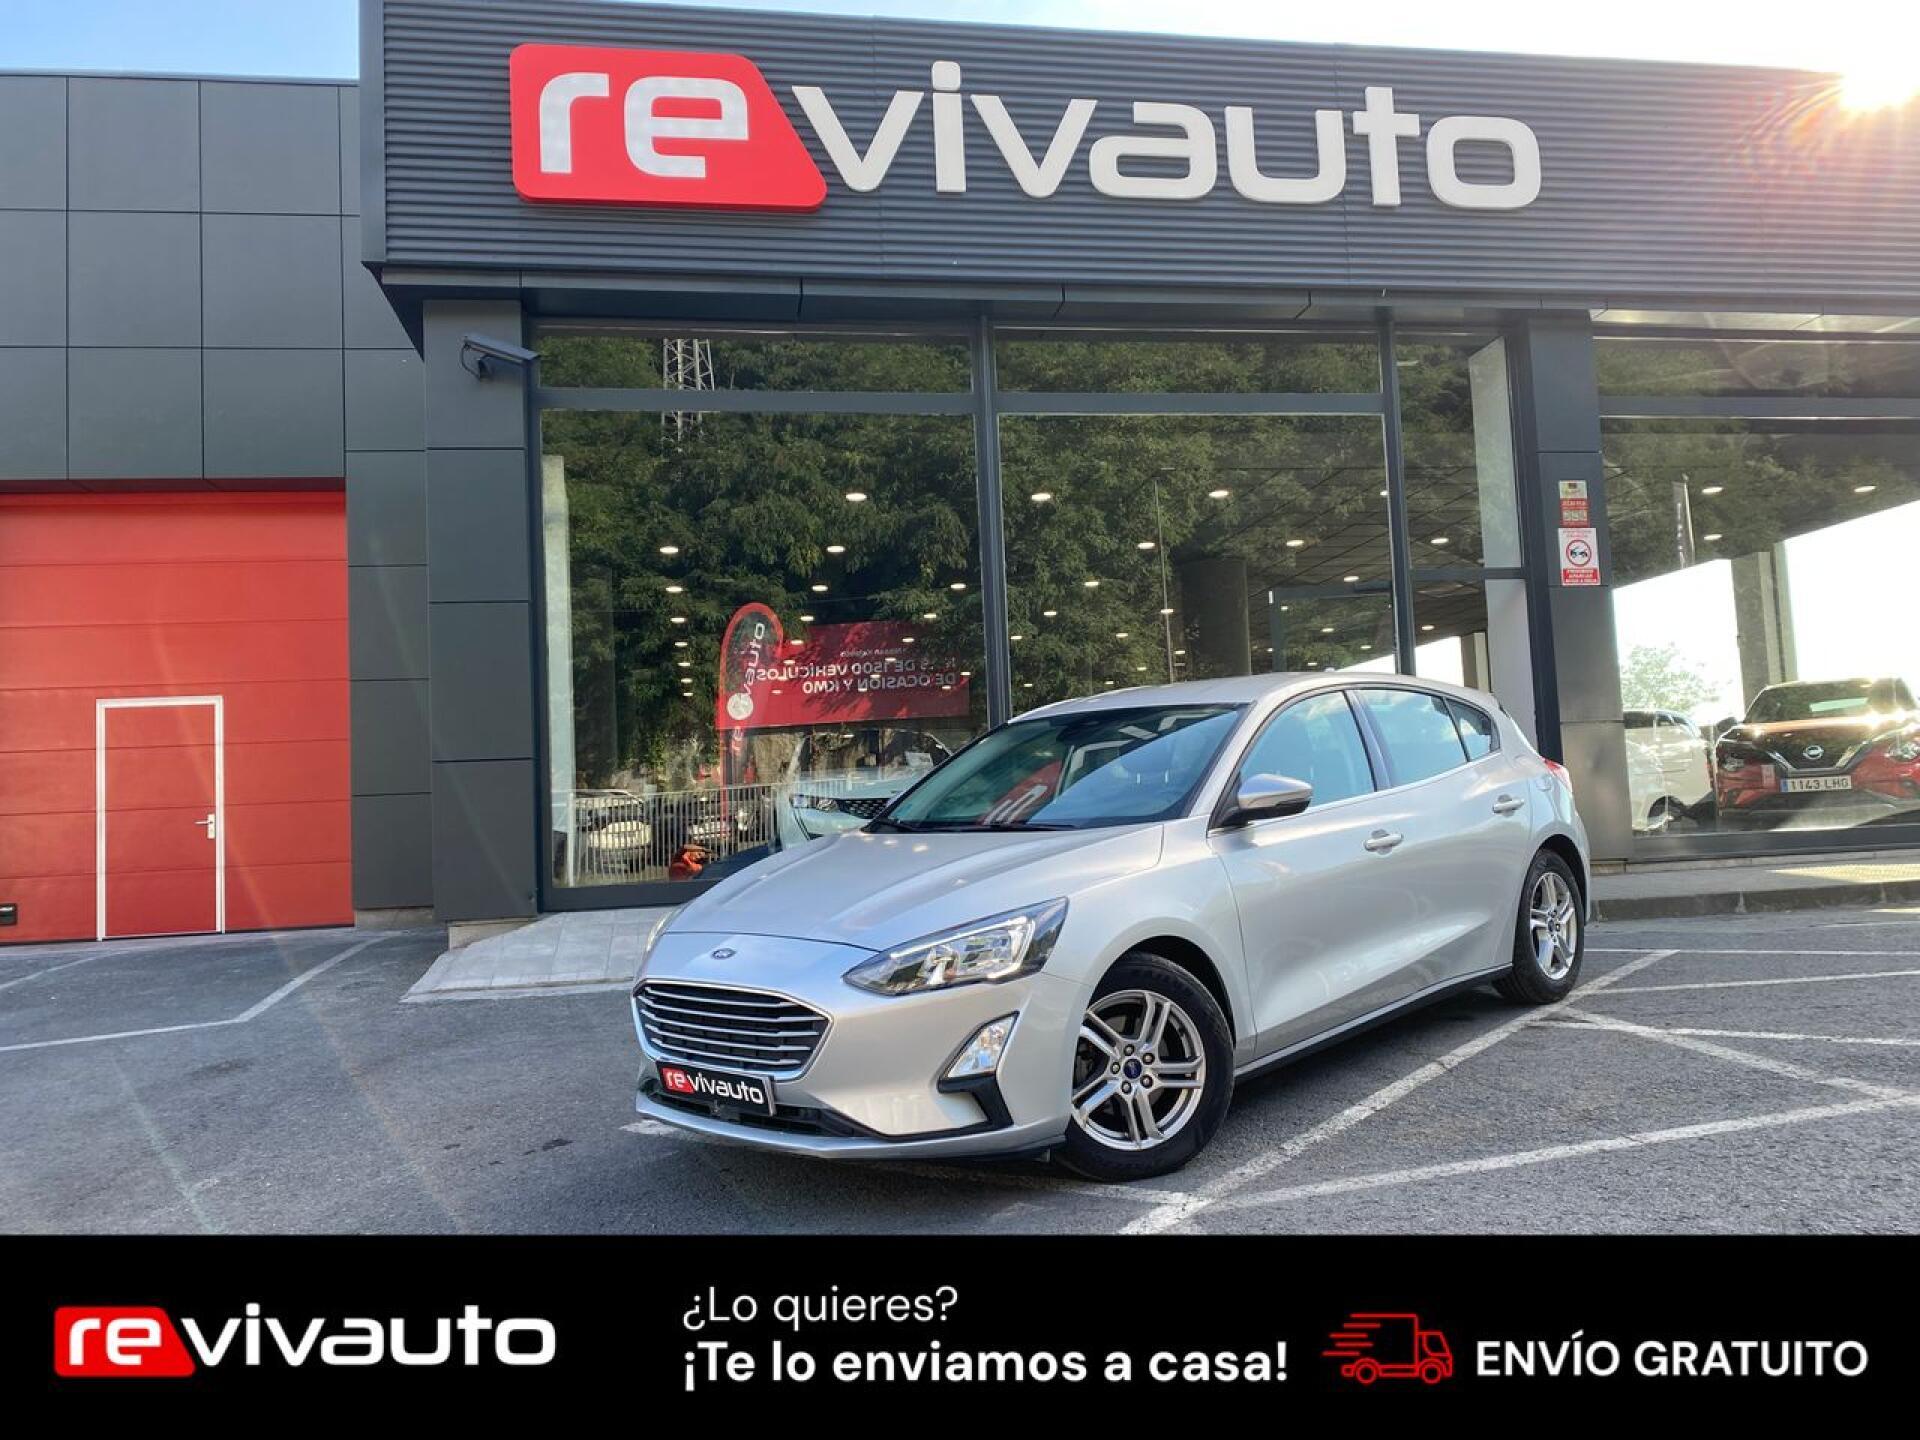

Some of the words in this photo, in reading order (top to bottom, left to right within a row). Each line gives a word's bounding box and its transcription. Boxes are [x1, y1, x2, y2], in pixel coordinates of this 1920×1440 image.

[539, 60, 1542, 211] revivauto
[1791, 779, 1820, 791] 1143
[665, 1067, 765, 1105] revivauto
